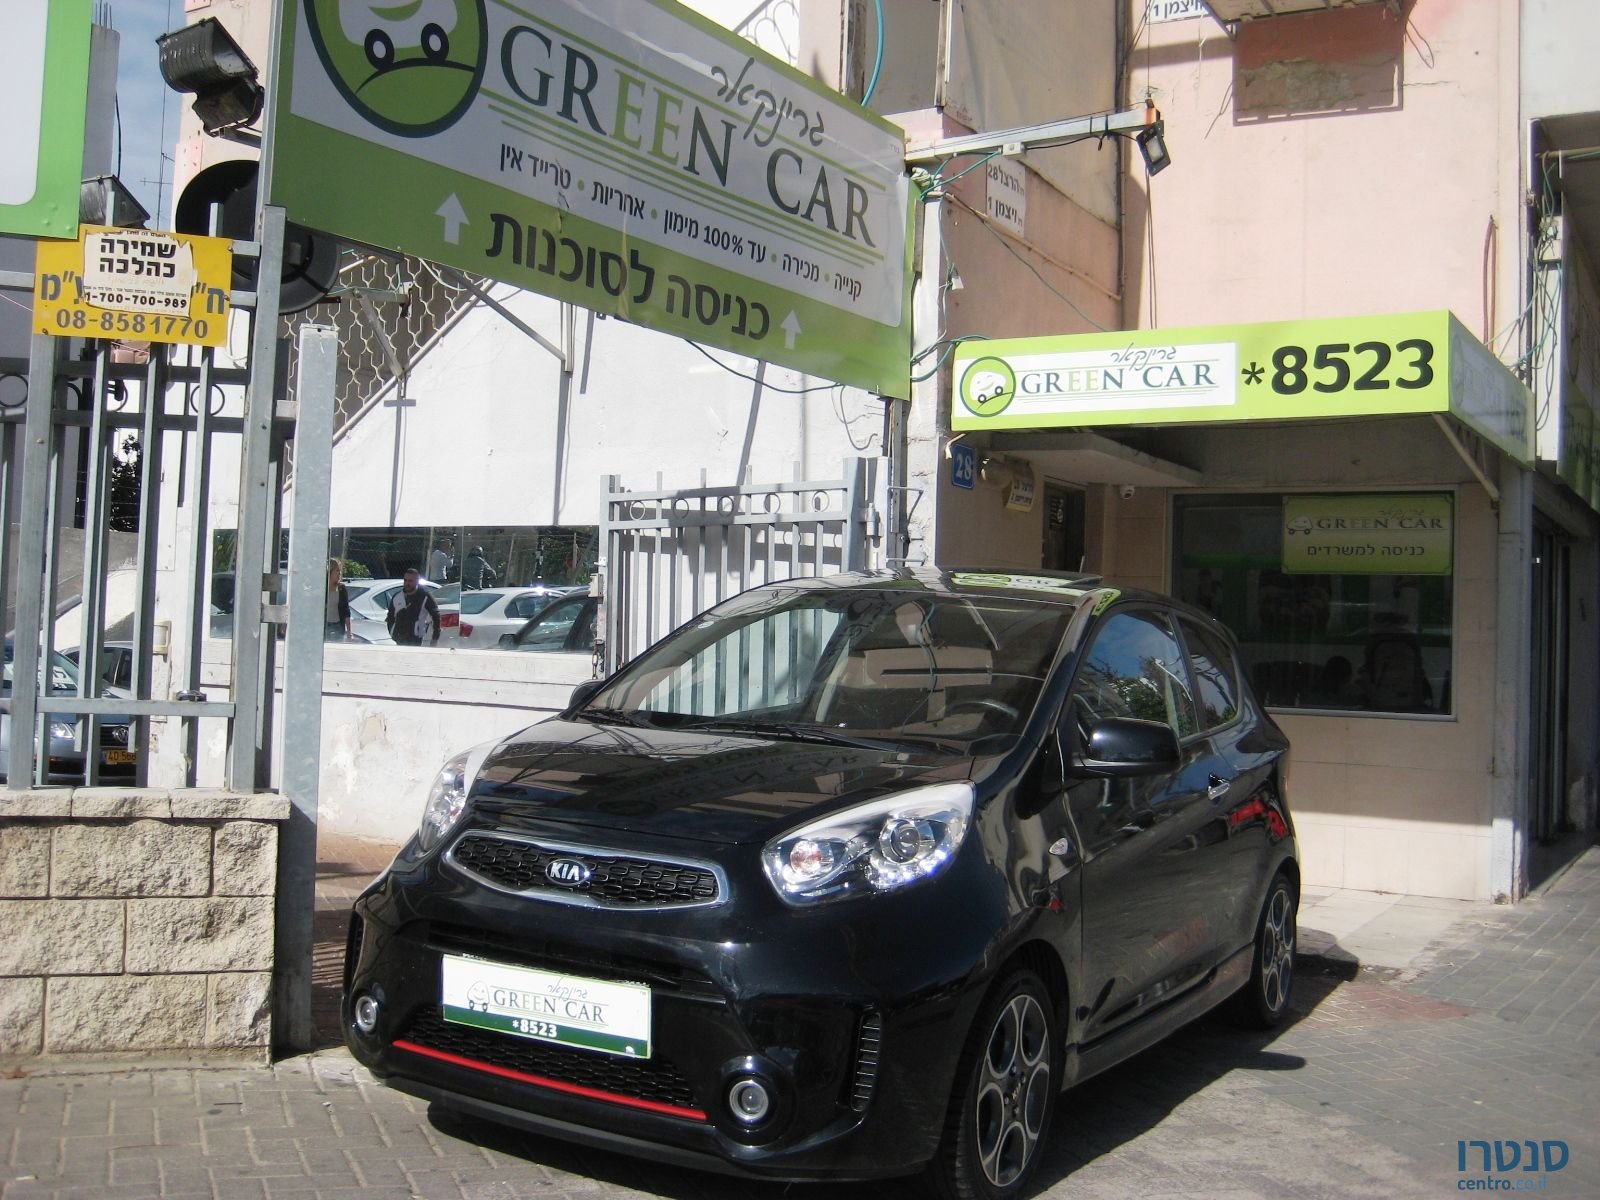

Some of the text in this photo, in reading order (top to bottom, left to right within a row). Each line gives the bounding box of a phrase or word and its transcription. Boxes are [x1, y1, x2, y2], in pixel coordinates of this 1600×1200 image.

[711, 57, 825, 147] גרינקאר
[500, 25, 877, 249] GREEN CAR
[500, 143, 862, 301] קנייה מכירה עד 100% מימון אחריות טרייד אין
[101, 238, 177, 258] שמירה
[100, 257, 176, 278] כהלכה
[485, 212, 771, 340] כניסה לסוכנות
[86, 292, 187, 309] 1-700-700-989
[56, 308, 208, 339] 08-8581770
[1110, 342, 1177, 371] גרינקאר
[1021, 367, 1125, 394] GREEN
[1142, 363, 1216, 388] CAR
[955, 453, 972, 481] 28
[1317, 517, 1443, 529] GREEN CAR
[1307, 543, 1425, 556] כניסה למשרדים
[549, 862, 580, 881] KIA
[493, 989, 604, 1023] GREEN CAR
